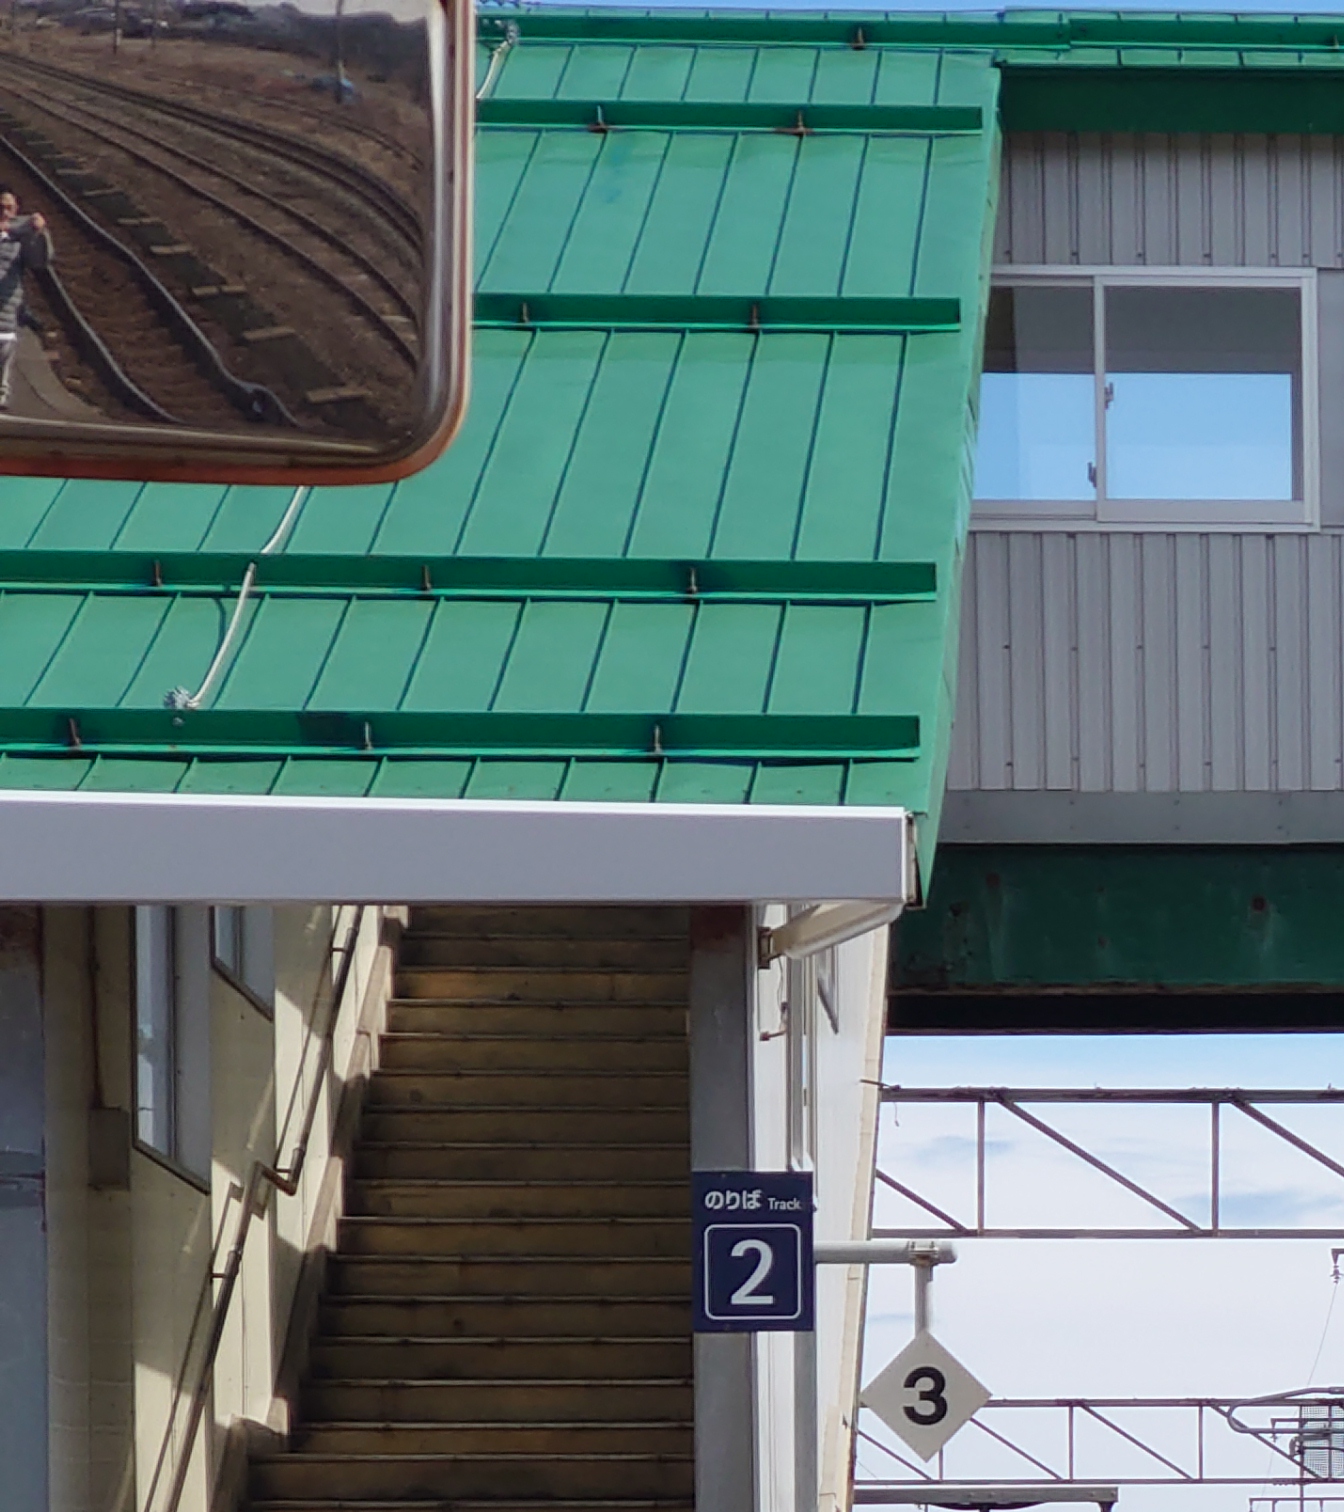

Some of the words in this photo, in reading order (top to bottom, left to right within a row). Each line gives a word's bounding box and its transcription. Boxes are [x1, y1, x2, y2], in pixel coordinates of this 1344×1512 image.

[704, 1189, 762, 1210] のりば
[767, 1197, 802, 1210] Track
[730, 1238, 774, 1305] 2
[902, 1365, 948, 1427] 3
